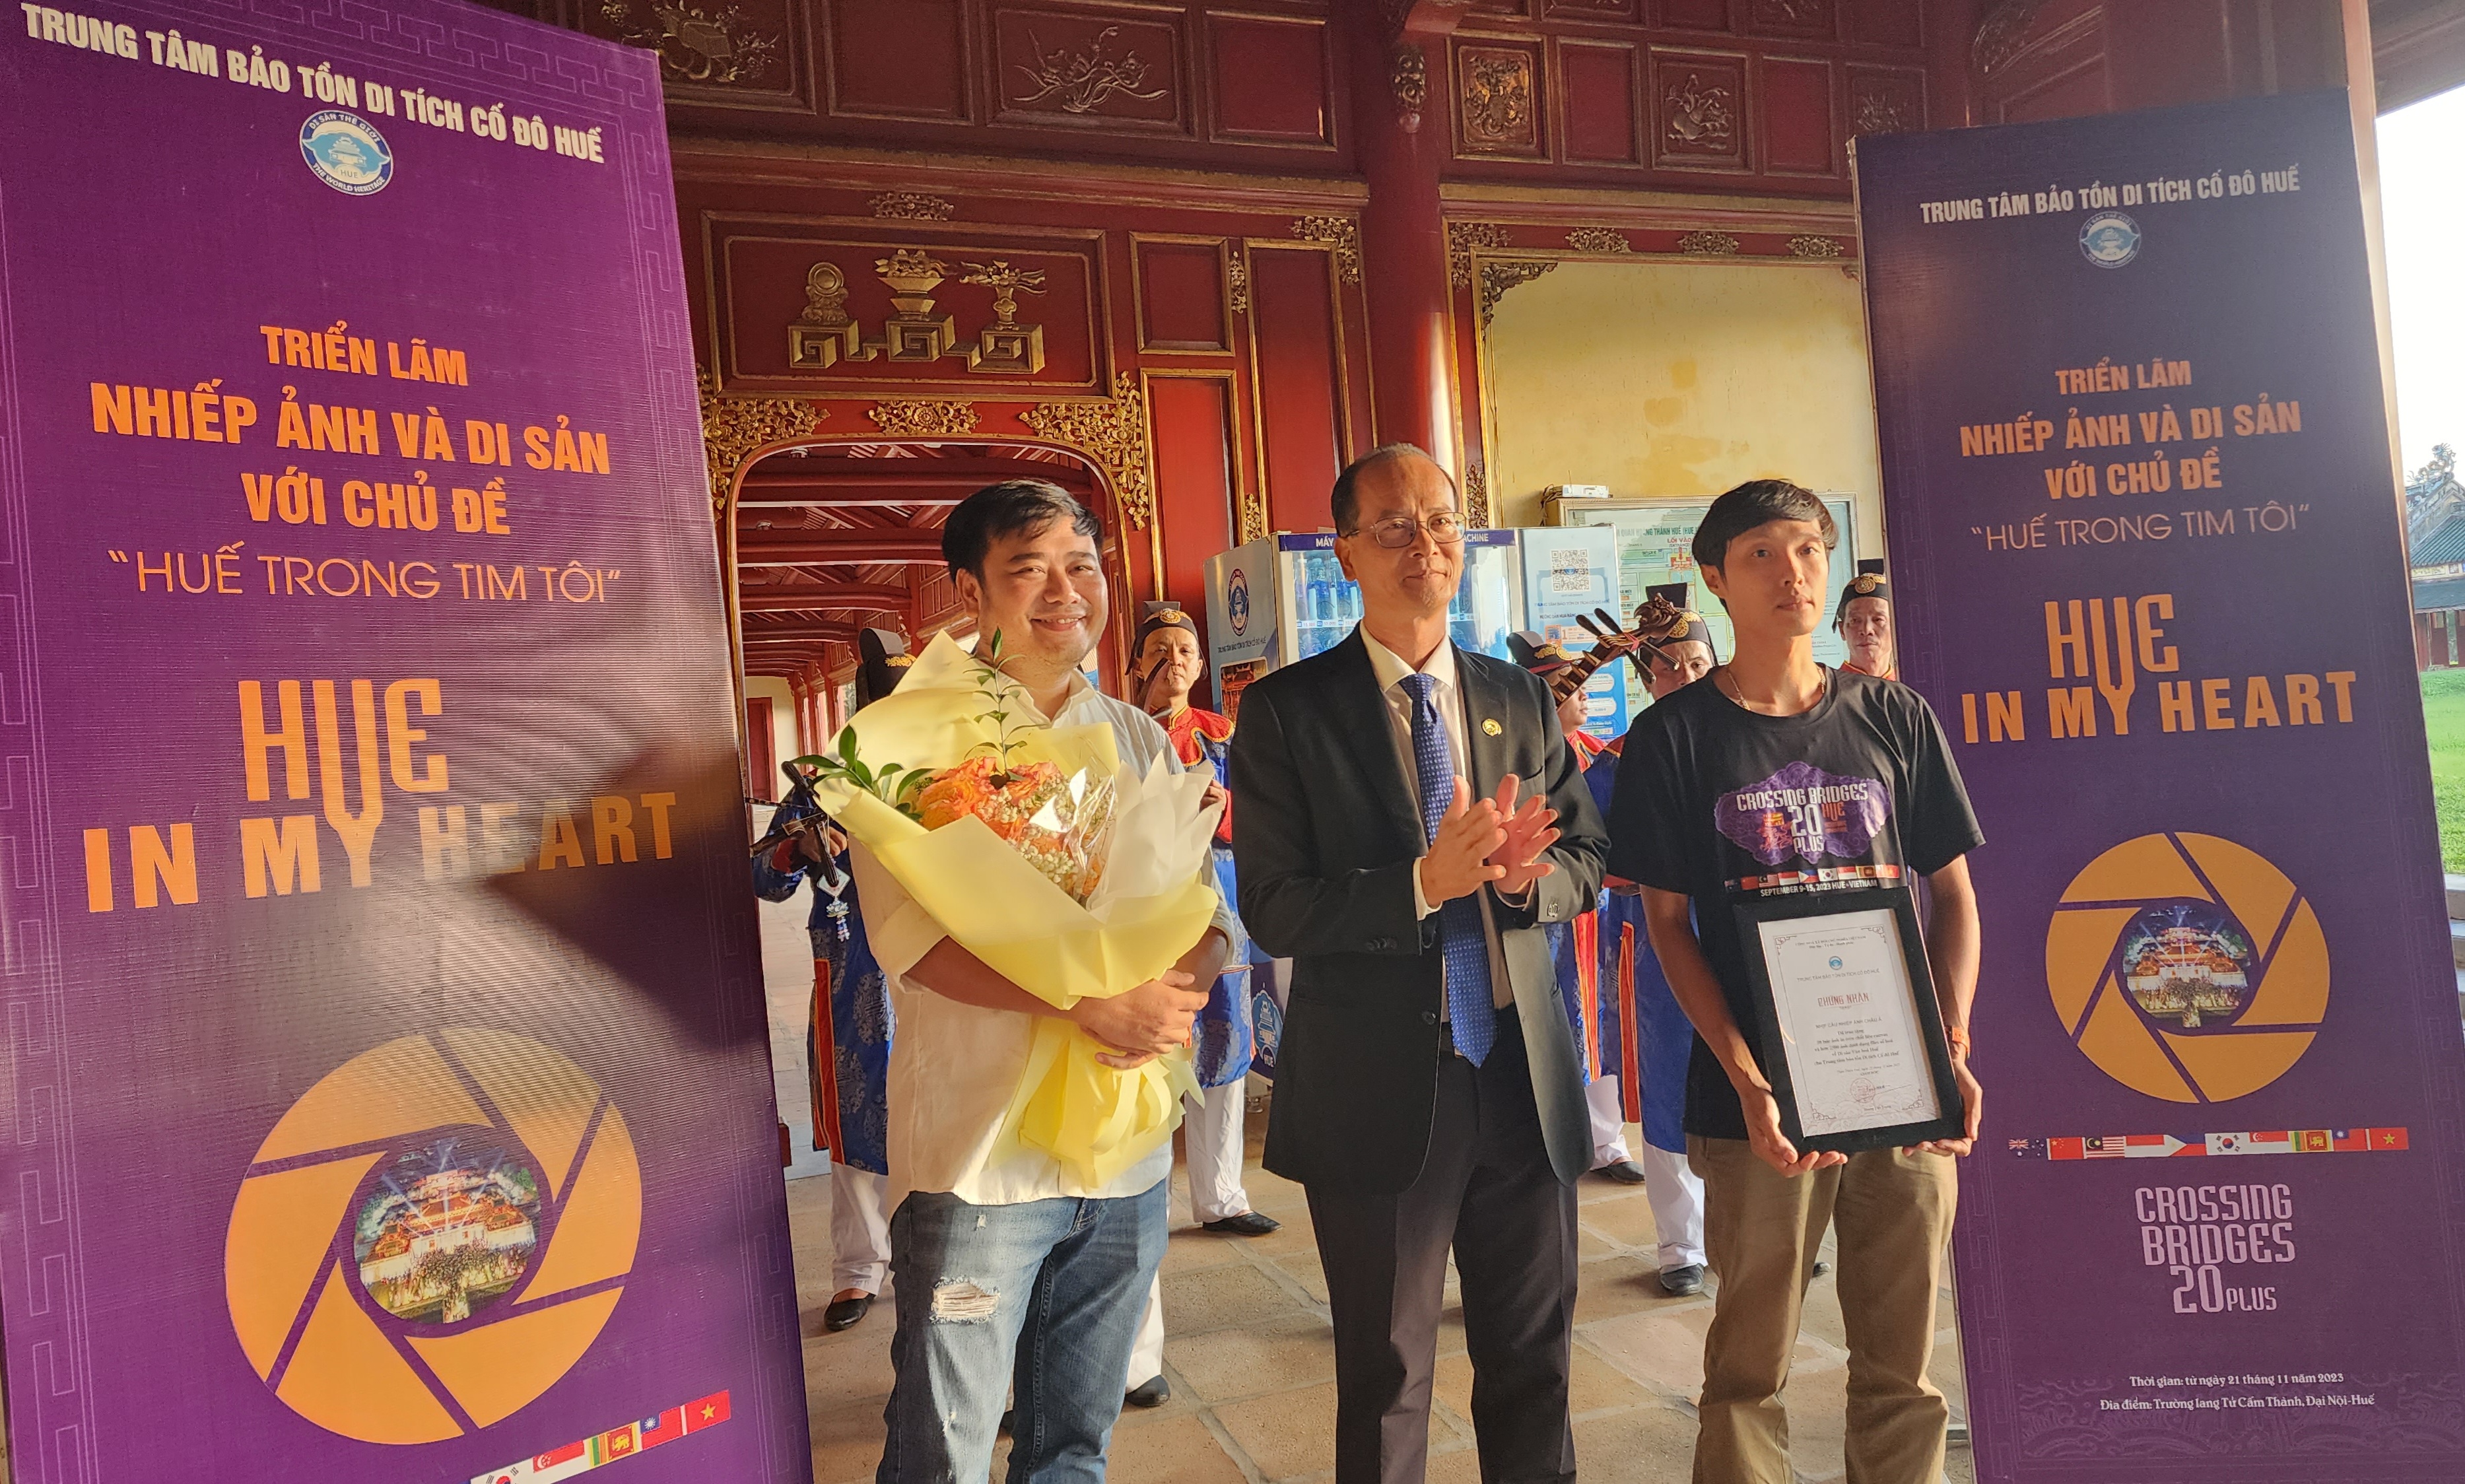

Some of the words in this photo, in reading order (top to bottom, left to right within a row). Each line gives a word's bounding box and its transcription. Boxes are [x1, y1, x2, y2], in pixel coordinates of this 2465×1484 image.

[21, 3, 138, 59] TRUNG
[146, 30, 219, 77] TÂM
[227, 45, 290, 92] BẢO
[297, 62, 358, 108] TỒN
[365, 82, 395, 116] DI
[401, 88, 464, 131] TÍCH
[471, 103, 506, 141] CỐ
[512, 116, 548, 150] ĐÔ
[554, 125, 604, 163] HUẾ
[313, 162, 327, 178] THE
[325, 175, 353, 191] WORLD
[353, 176, 386, 193] HERITAGE
[340, 169, 358, 178] HUE
[1920, 199, 1983, 223] TRUNG
[1988, 192, 2029, 217] TÂM
[2035, 185, 2074, 213] BẢO
[2079, 181, 2117, 209] TỒN
[2123, 184, 2142, 205] DI
[2147, 178, 2192, 203] TÍCH
[2197, 169, 2223, 199] CỐ
[2229, 170, 2255, 195] ĐÔ
[2261, 163, 2300, 193] HUẾ
[260, 321, 378, 375] TRIỂN
[388, 338, 468, 386] LÃM
[2055, 356, 2129, 394] TRIỂN
[2137, 358, 2192, 388] LÃM
[90, 379, 257, 444] NHIẾP
[277, 386, 380, 455] ẢNH
[391, 406, 456, 461] VÀ
[465, 420, 511, 466] DI
[523, 415, 610, 474] SẢN
[1961, 411, 2054, 456] NHIẾP
[2066, 408, 2130, 448] ẢNH
[2142, 404, 2182, 444] VÀ
[2190, 407, 2223, 439] DI
[2234, 393, 2301, 436] SẢN
[2044, 460, 2097, 499] VỚI
[2107, 450, 2171, 495] CHỦ
[2180, 446, 2222, 489] ĐỀ
[241, 466, 327, 524] VỚI
[343, 471, 438, 531] CHỦ
[452, 477, 511, 534] ĐỀ
[1316, 537, 1334, 547] MÁY
[2055, 514, 2172, 545] TRONG
[2180, 509, 2235, 537] TIM
[257, 556, 440, 598] TRONG
[452, 563, 528, 603] TIM
[2044, 593, 2180, 689] HUE
[1962, 691, 2025, 743] IN
[2046, 683, 2136, 739] MY
[2158, 671, 2357, 733] HEART
[237, 678, 449, 816] HUE
[1736, 788, 1807, 812] CROSSING
[1808, 782, 1869, 805] BRIDGES
[1787, 803, 1823, 837] 20
[1821, 801, 1846, 822] HUE
[83, 821, 199, 914] IN
[238, 811, 384, 901] MY
[418, 792, 677, 884] HEART
[1793, 835, 1825, 854] PLUS
[1760, 885, 1799, 897] SEPTEMBER
[1815, 883, 1831, 891] 2023
[2134, 1183, 2294, 1224] CROSSING
[2141, 1221, 2297, 1267] BRIDGES
[2169, 1263, 2225, 1314] 20
[2224, 1286, 2278, 1312] PLUS
[2121, 1396, 2153, 1409] điểm:
[2153, 1398, 2194, 1411] Trường
[2195, 1398, 2220, 1410] lang
[2237, 1396, 2265, 1407] Cấm
[2266, 1395, 2305, 1407] Thành,
[2305, 1395, 2326, 1408] Đại
[2129, 1376, 2155, 1387] Thời
[2156, 1375, 2184, 1388] gian:
[2185, 1375, 2197, 1386] từ
[2199, 1374, 2226, 1388] ngày
[2227, 1375, 2240, 1384] 21
[2243, 1374, 2275, 1386] tháng
[2278, 1374, 2289, 1384] 11
[2318, 1372, 2344, 1383] 2023
